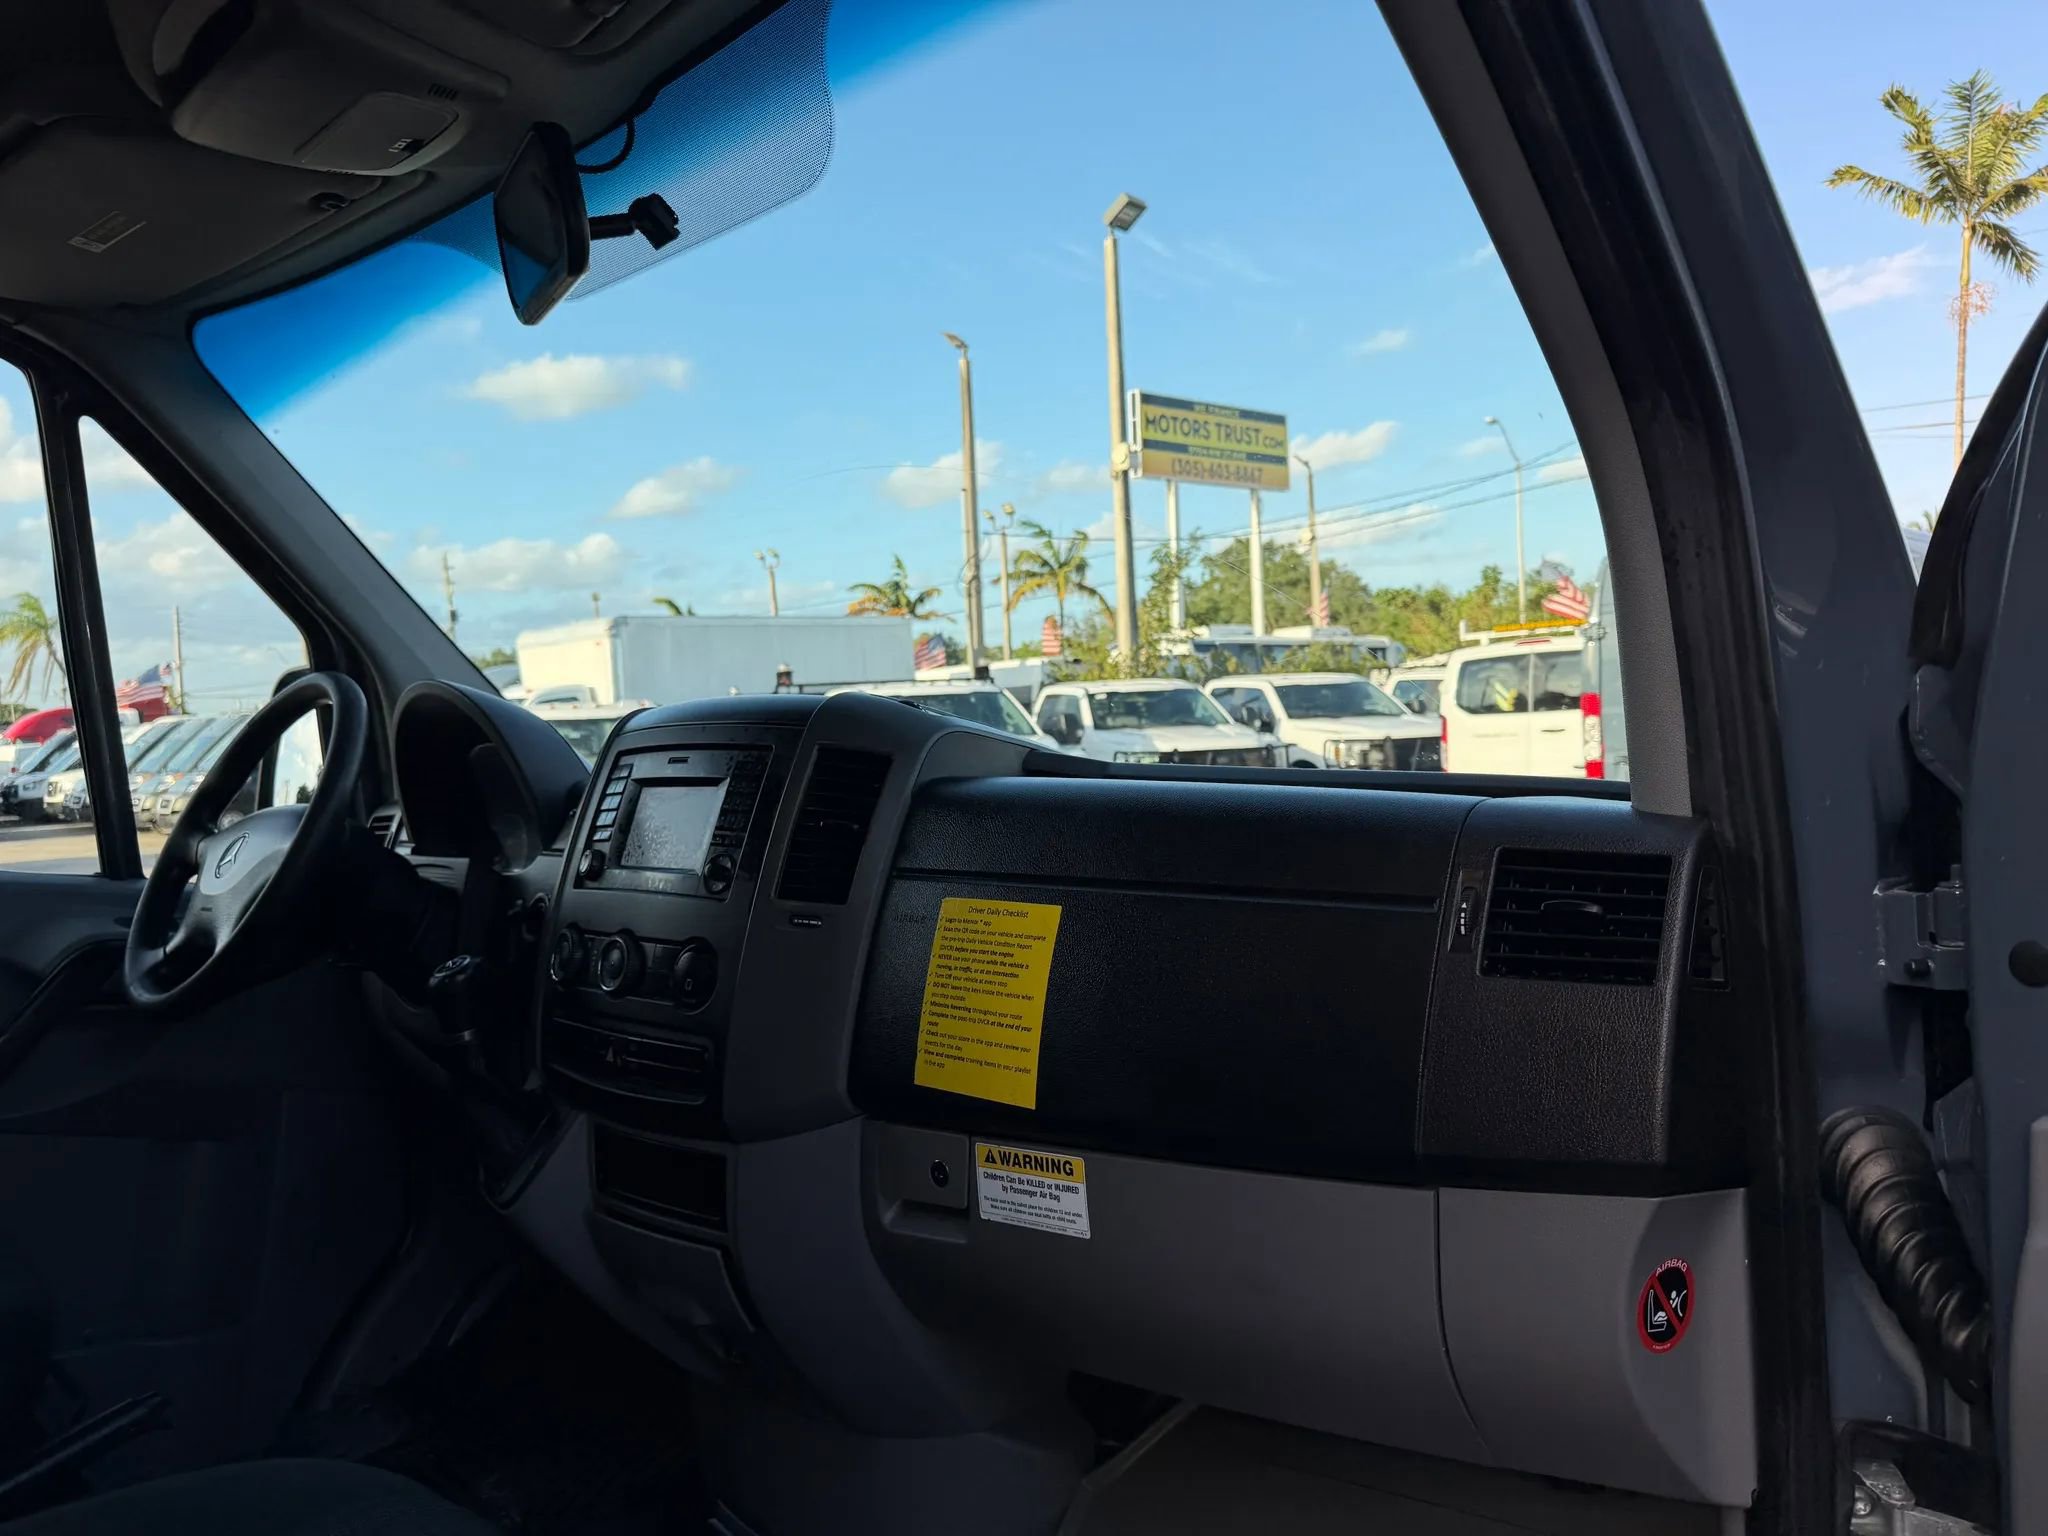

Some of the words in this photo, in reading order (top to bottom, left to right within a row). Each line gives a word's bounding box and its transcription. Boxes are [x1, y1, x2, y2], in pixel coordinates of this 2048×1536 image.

[1143, 414, 1211, 440] MOTORS
[1215, 422, 1262, 448] TRUST
[968, 906, 985, 914] Driver
[987, 908, 1001, 916] Daily
[1002, 909, 1028, 918] Checklist
[994, 940, 1016, 948] Condition
[1016, 942, 1032, 950] Report
[998, 1150, 1074, 1176] WARNING
[984, 1172, 1005, 1182] Children
[1006, 1176, 1016, 1184] Can
[1018, 1177, 1024, 1185] Be
[1026, 1179, 1045, 1189] KILLED
[1054, 1183, 1079, 1194] INJURED
[1002, 1184, 1008, 1194] by
[1010, 1186, 1038, 1198] Passenger
[1049, 1192, 1060, 1202] Bag
[1655, 1258, 1688, 1277] AIRBAG
